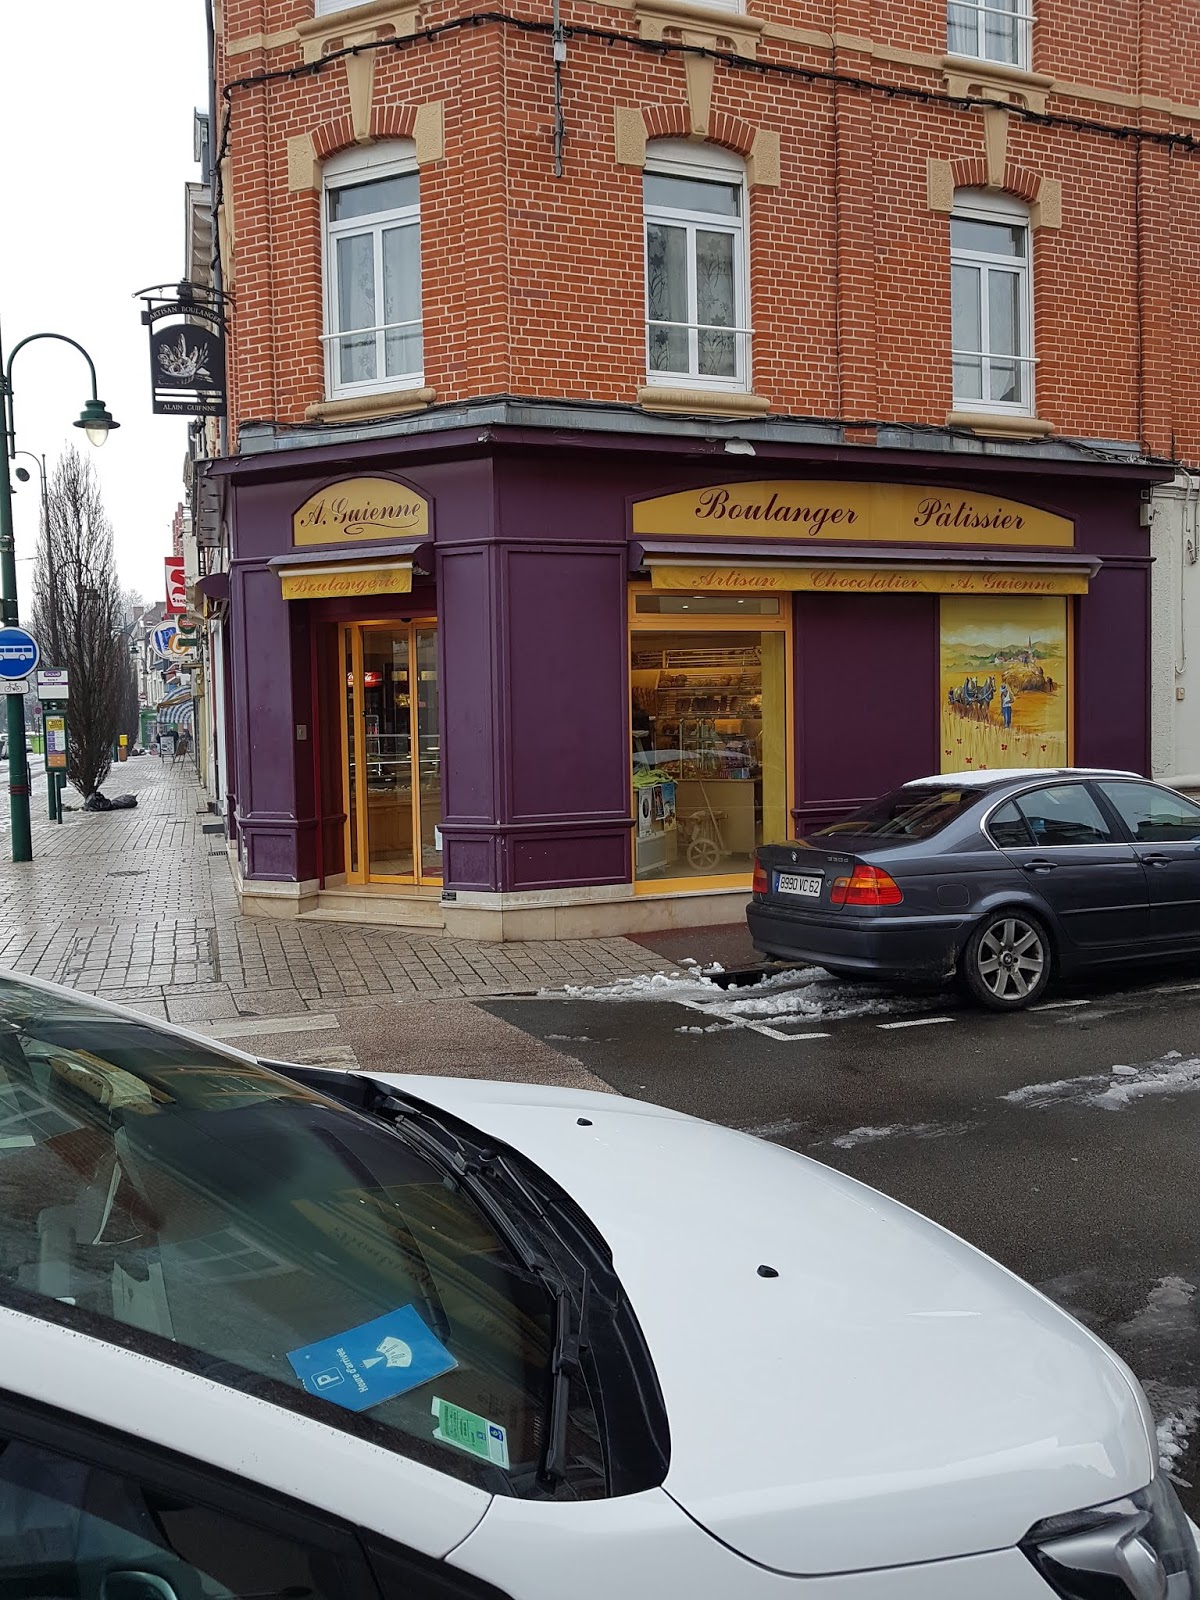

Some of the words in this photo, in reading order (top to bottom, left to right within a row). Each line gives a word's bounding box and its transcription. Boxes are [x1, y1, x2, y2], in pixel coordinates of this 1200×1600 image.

[149, 306, 178, 320] ARTISAN
[181, 305, 222, 324] BOULANGER
[300, 498, 327, 527] A.
[331, 497, 422, 535] Guienne
[694, 487, 859, 536] Boulanger
[913, 497, 1026, 530] Pâtissier
[290, 575, 400, 594] Boulangerie
[691, 569, 778, 587] Artisan
[810, 570, 921, 589] Chocolatier
[950, 574, 974, 590] A.
[981, 572, 1056, 591] Guienne
[780, 876, 798, 890] 8990
[799, 878, 809, 892] VC
[809, 880, 820, 894] 62
[316, 1374, 340, 1386] P
[352, 1373, 369, 1393] Heure
